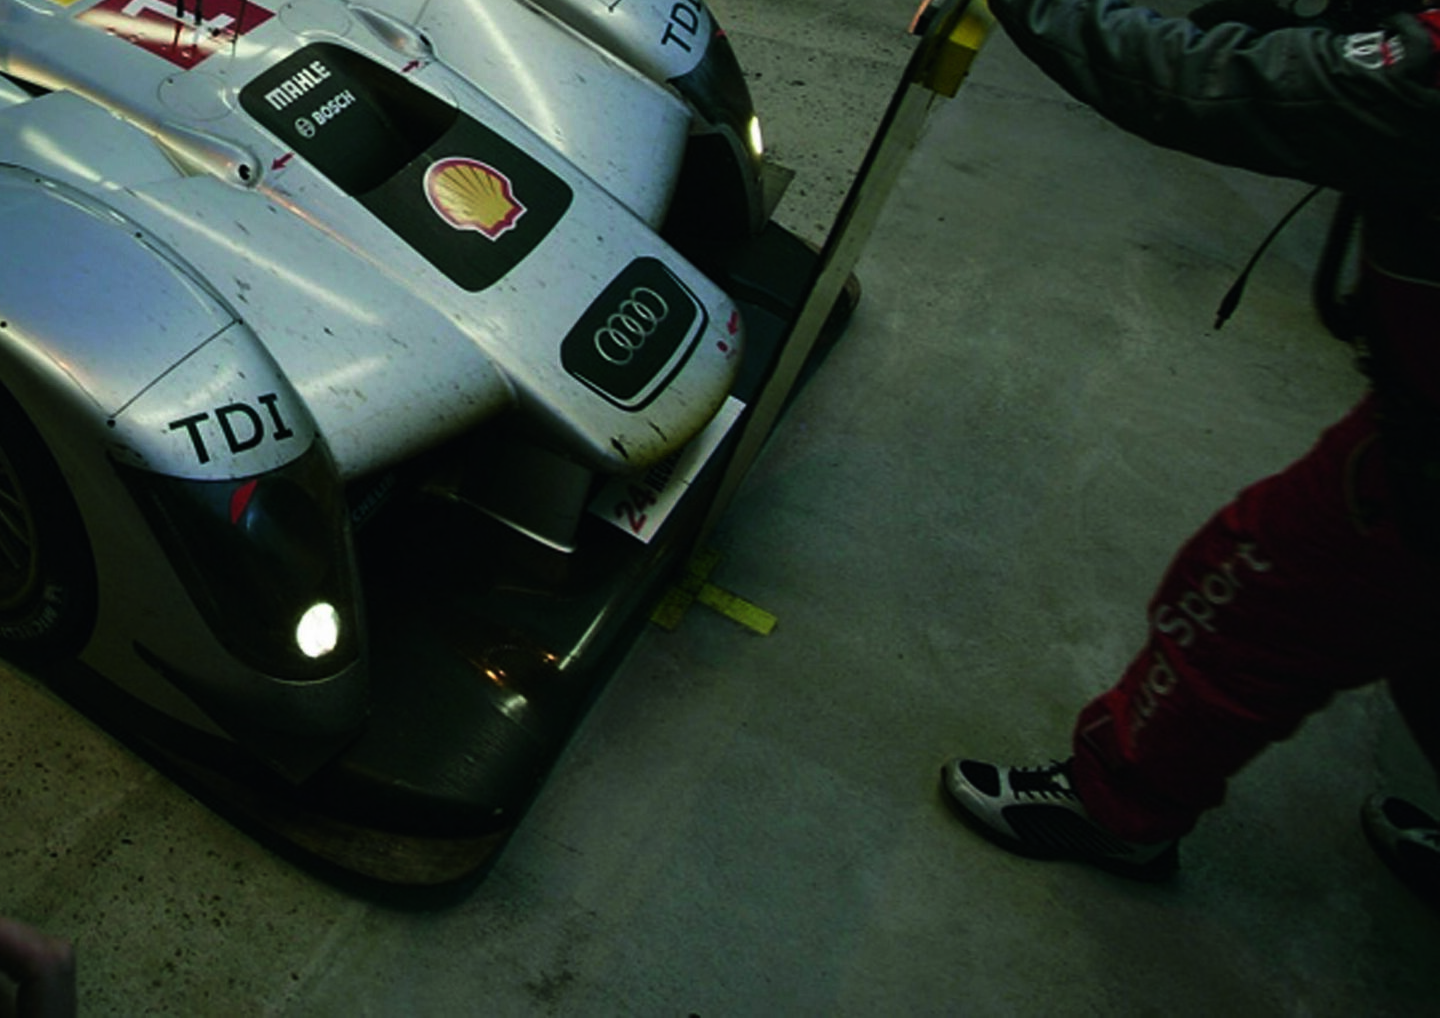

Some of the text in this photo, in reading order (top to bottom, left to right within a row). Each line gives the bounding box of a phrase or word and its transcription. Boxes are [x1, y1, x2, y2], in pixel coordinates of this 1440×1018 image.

[264, 61, 331, 111] MAHLE
[311, 89, 356, 126] BOSCH
[168, 392, 293, 464] TDI
[615, 483, 657, 534] 24
[1155, 542, 1273, 647] Sport
